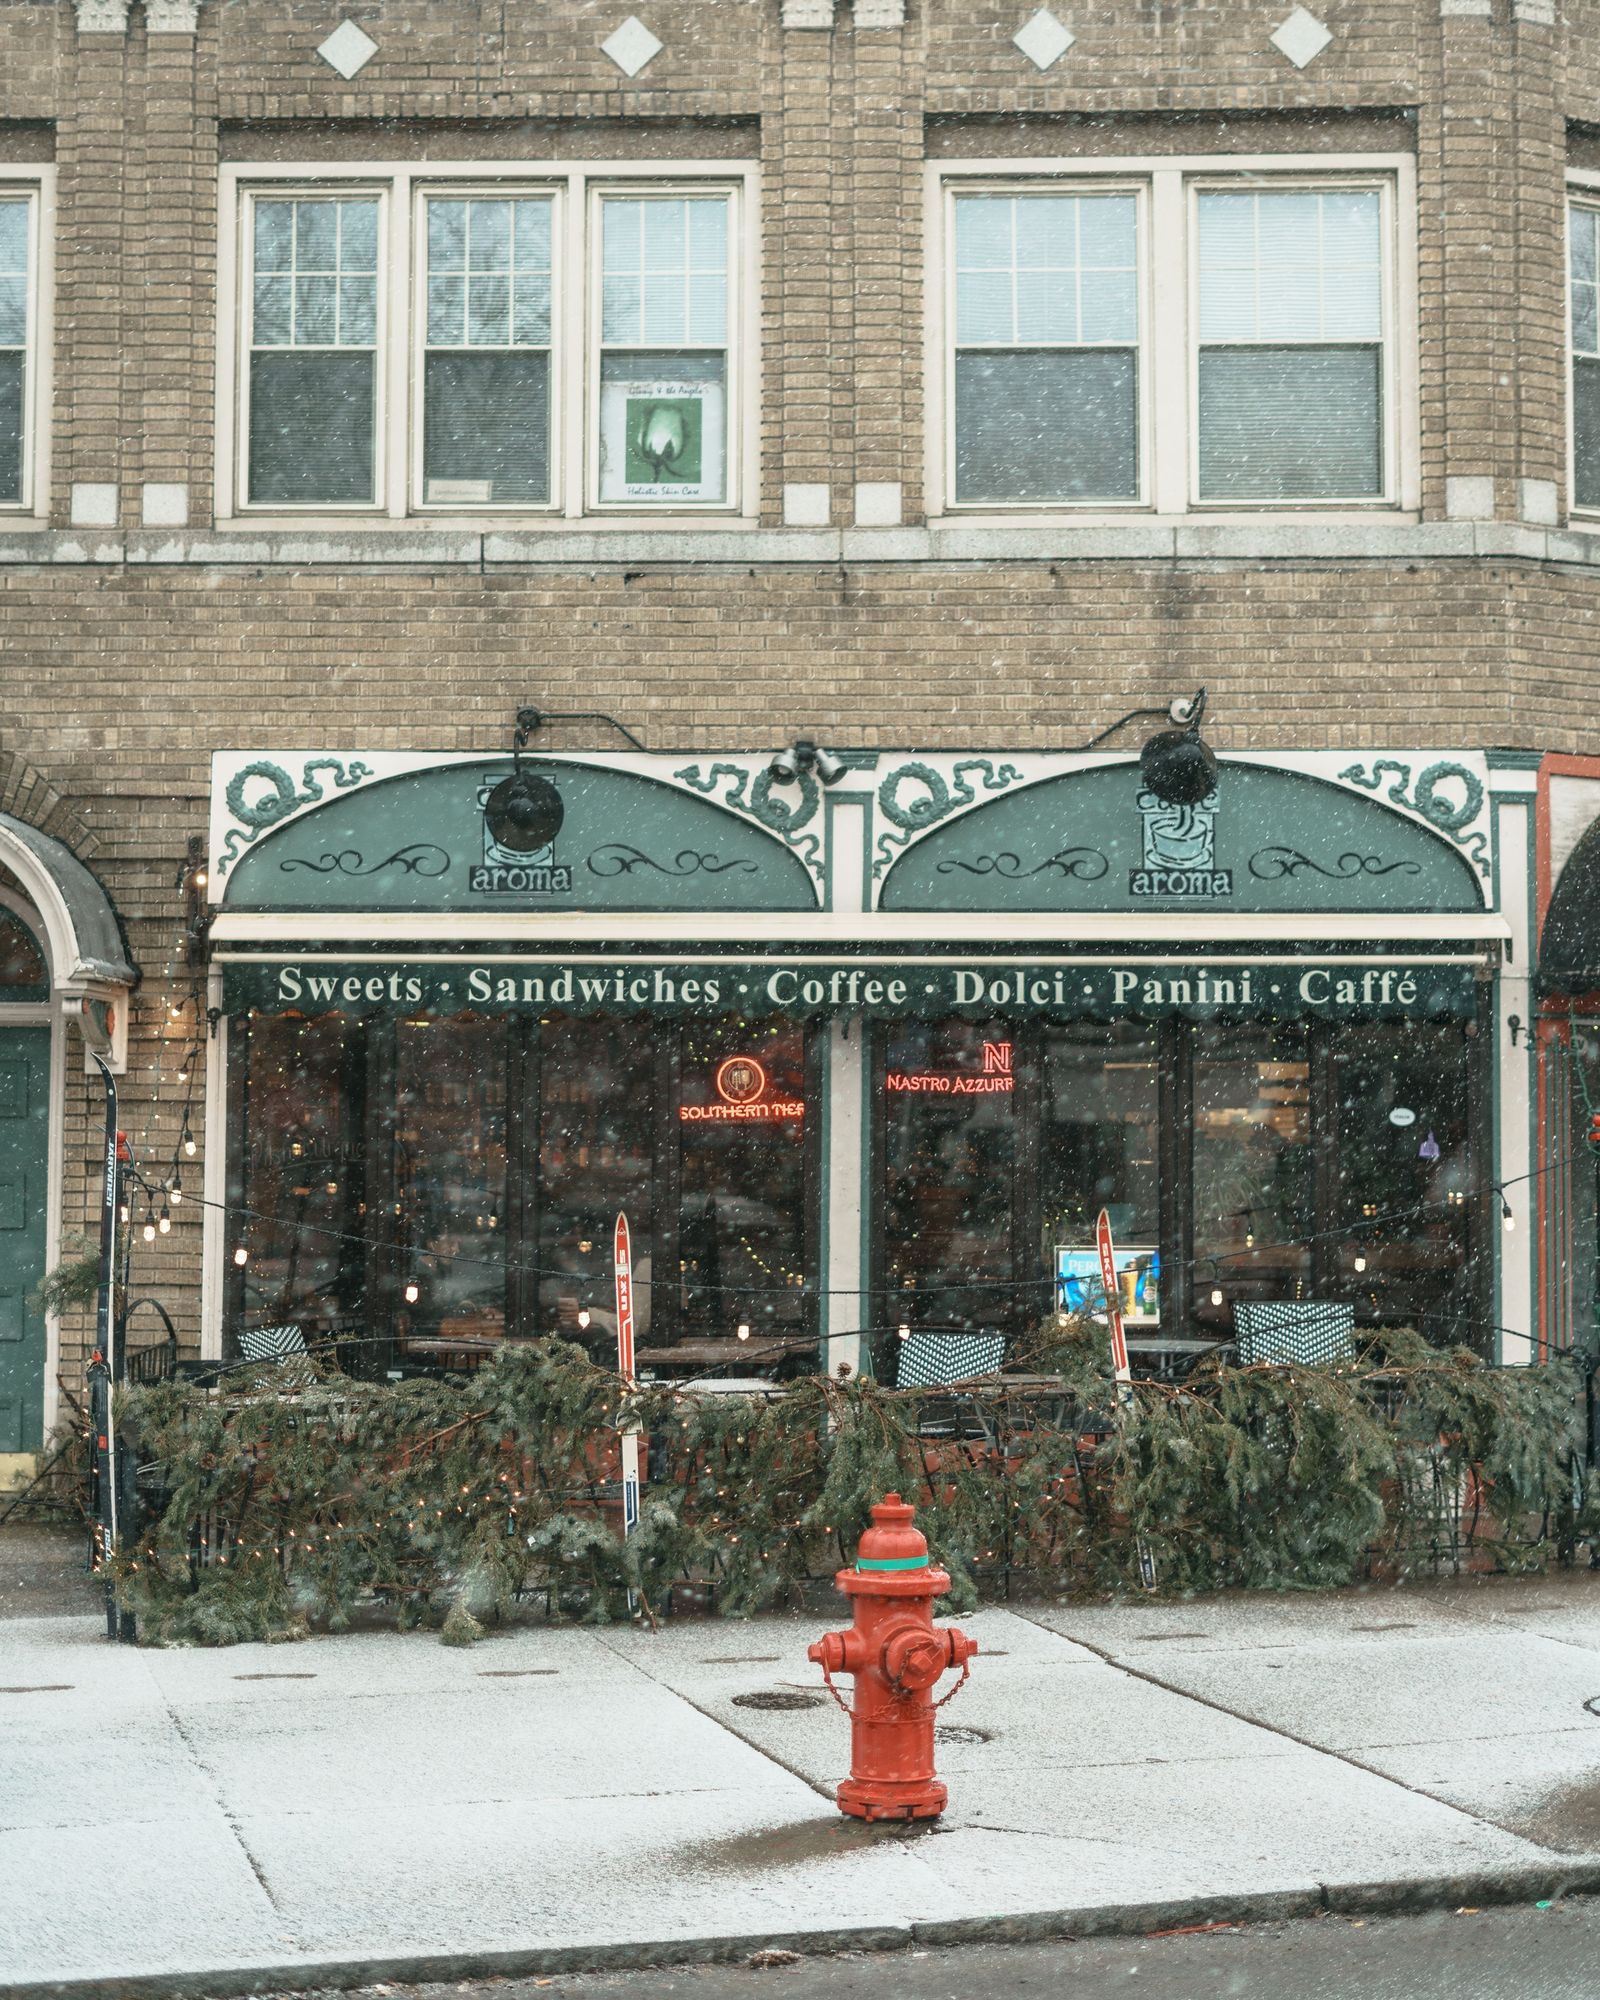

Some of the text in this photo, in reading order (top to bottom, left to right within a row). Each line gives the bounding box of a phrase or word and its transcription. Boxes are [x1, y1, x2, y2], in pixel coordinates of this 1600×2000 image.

[628, 486, 700, 496] Holistic Skin Care
[472, 868, 571, 891] aroma
[1133, 871, 1232, 895] aroma
[278, 967, 1418, 1004] Sweets Sandwiches Coffee Dolci Panini Caffé
[983, 1043, 1011, 1073] N
[887, 1074, 950, 1091] NASTRO
[681, 1103, 769, 1120] SOUTHERN
